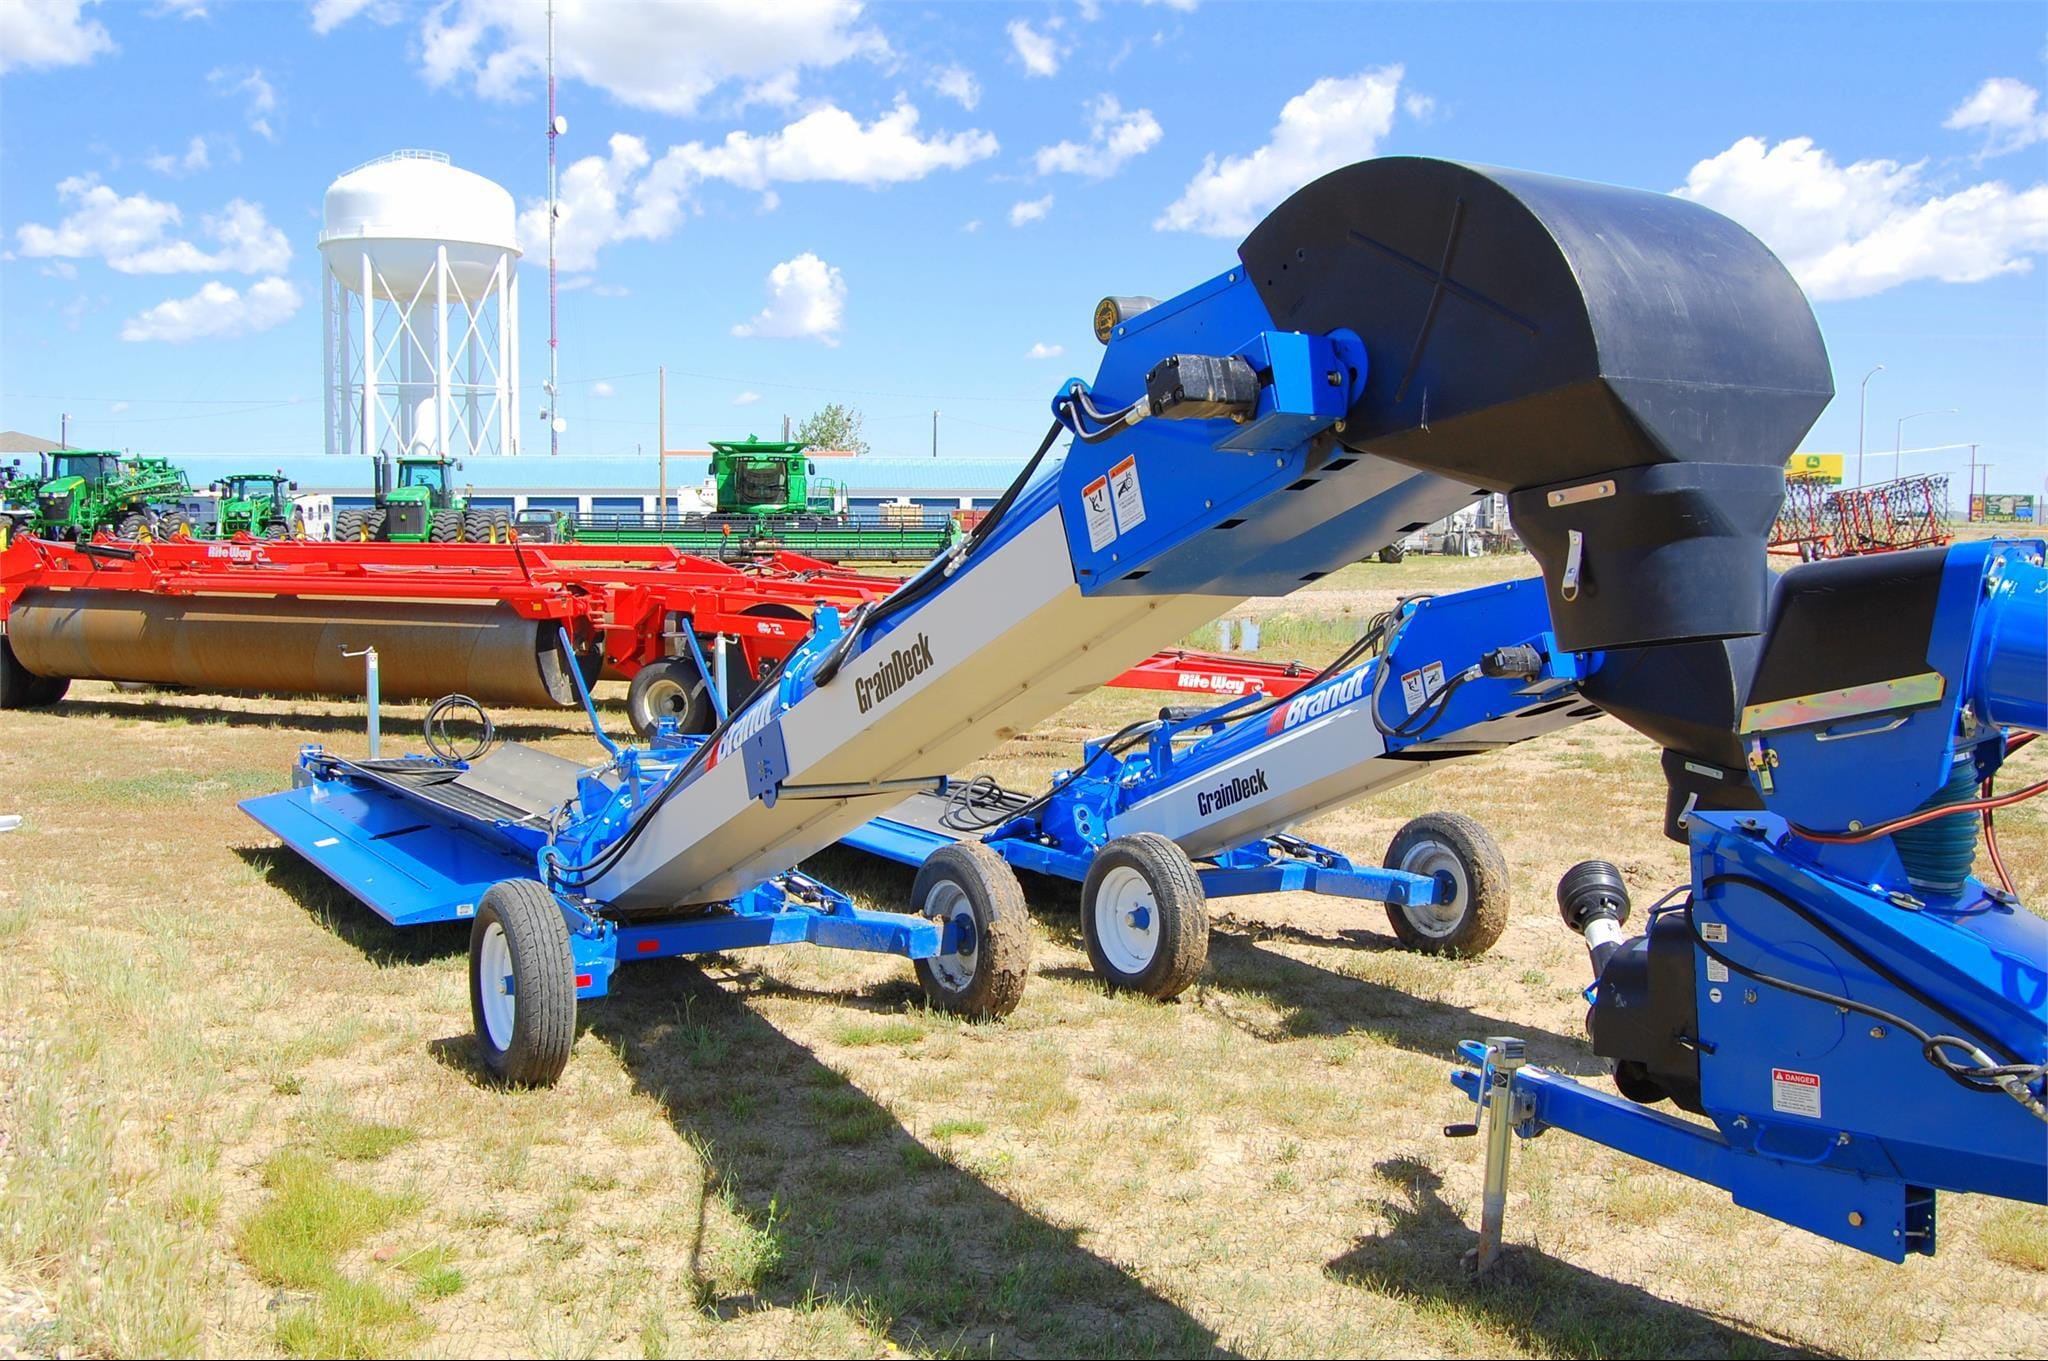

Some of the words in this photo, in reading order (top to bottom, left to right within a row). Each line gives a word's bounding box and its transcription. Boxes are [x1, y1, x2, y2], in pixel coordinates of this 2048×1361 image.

[208, 546, 228, 558] Rite
[229, 546, 252, 561] Way
[855, 632, 934, 714] GrainDeck
[1178, 673, 1209, 688] Rite
[1211, 675, 1245, 694] Way
[1284, 665, 1371, 730] Brandt
[1197, 768, 1269, 817] GrainDeck
[1785, 1073, 1816, 1085] DANGER
